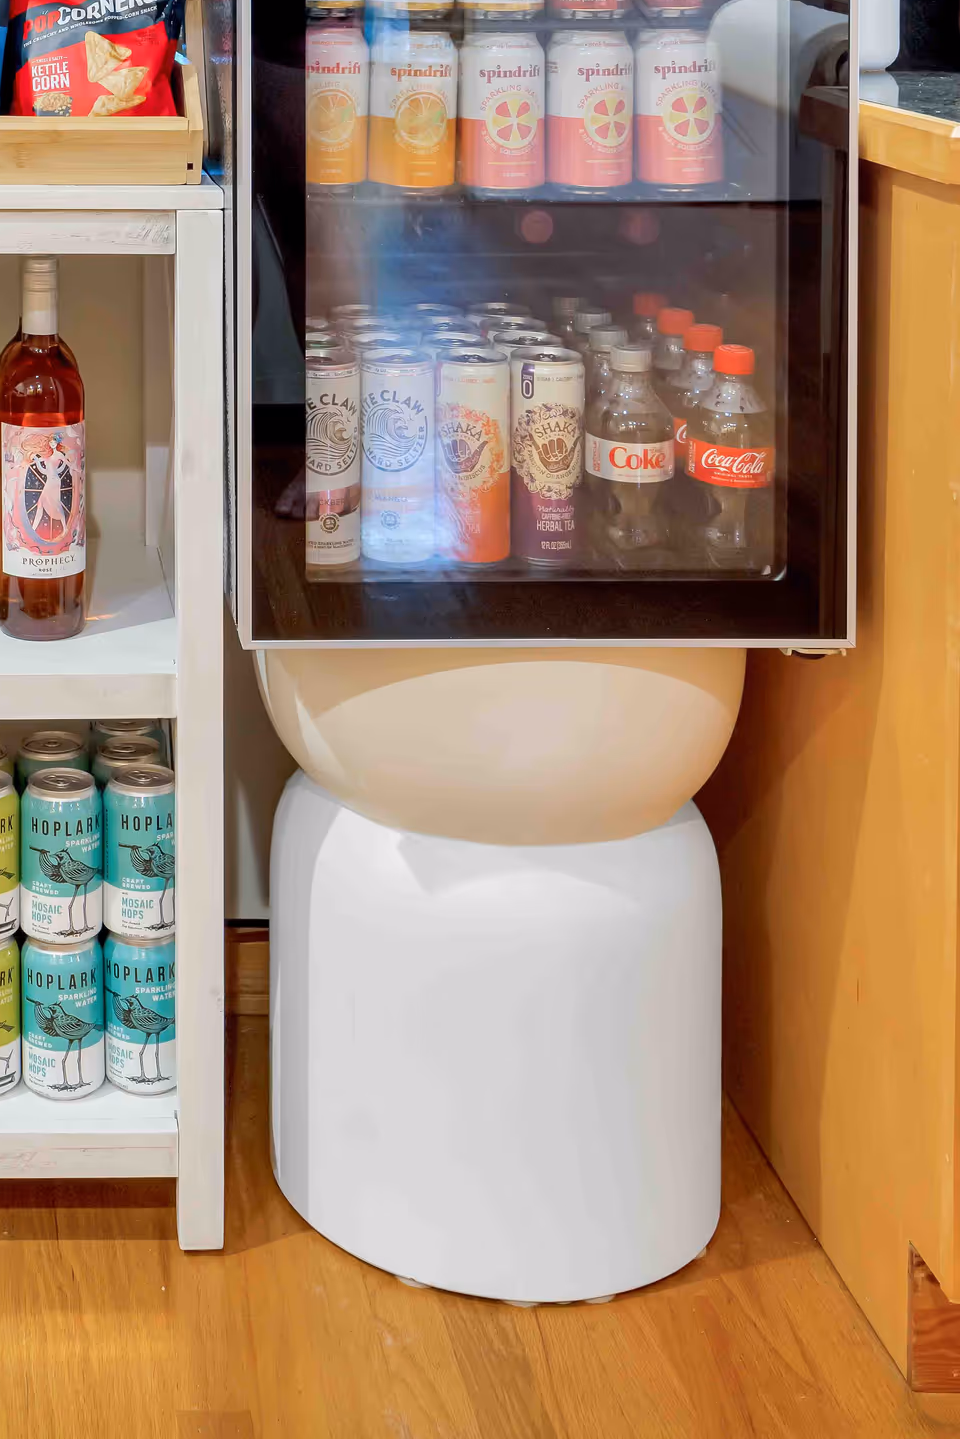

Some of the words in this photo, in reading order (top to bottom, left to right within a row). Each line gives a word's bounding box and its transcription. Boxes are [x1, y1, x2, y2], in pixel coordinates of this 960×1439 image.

[23, 39, 33, 48] THE
[32, 31, 58, 43] CRUNCHY
[58, 26, 69, 35] AND
[70, 19, 104, 30] WHOLESOME
[140, 5, 158, 15] SNACK
[31, 62, 69, 78] KETTLE
[32, 73, 71, 92] CORN
[655, 79, 698, 107] SPARKLING
[480, 84, 522, 112] SPARKLING
[576, 81, 620, 110] SPARKLING
[319, 392, 358, 418] CLAW
[379, 388, 425, 416] CLAW
[440, 421, 484, 442] SHAKA
[534, 420, 577, 438] SHAKA
[336, 425, 359, 468] SELTZER
[366, 446, 393, 468] HARD
[397, 425, 427, 467] SELTZER
[608, 446, 666, 470] Coke
[700, 447, 767, 475] Coca-Cola
[536, 519, 563, 532] HERBAL
[564, 519, 576, 531] TEA
[21, 553, 77, 568] PROPHECY
[31, 813, 100, 837] HOPLARK
[31, 899, 63, 915] MOSAIC
[121, 896, 154, 910] MOSAIC
[121, 907, 144, 920] HOPS
[31, 911, 53, 924] HOPS
[27, 966, 98, 991] HOPLARK
[105, 957, 176, 984] HOPLARK
[58, 987, 98, 1002] SPARKLING
[75, 995, 98, 1008] WATER
[28, 1051, 57, 1068] MOSAIC
[28, 1062, 47, 1078] HOPS
